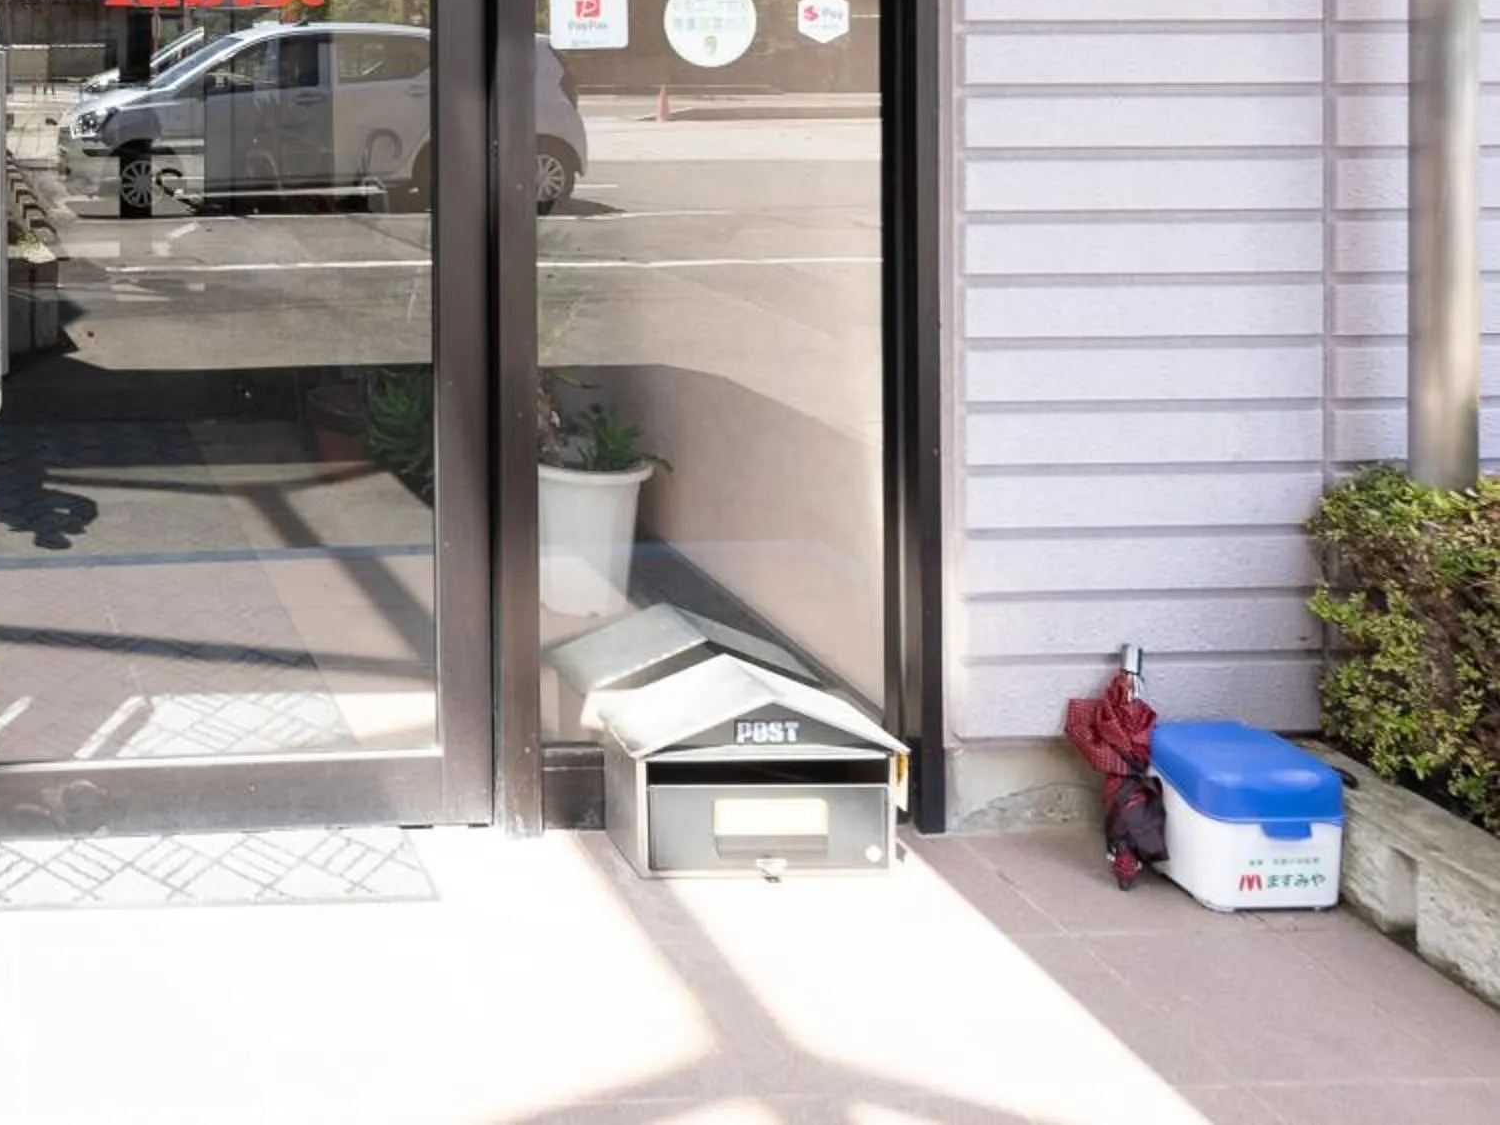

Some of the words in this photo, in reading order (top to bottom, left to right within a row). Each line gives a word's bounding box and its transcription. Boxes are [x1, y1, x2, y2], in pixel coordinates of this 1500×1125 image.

[736, 720, 800, 743] POST
[1267, 873, 1326, 889] ますみや
